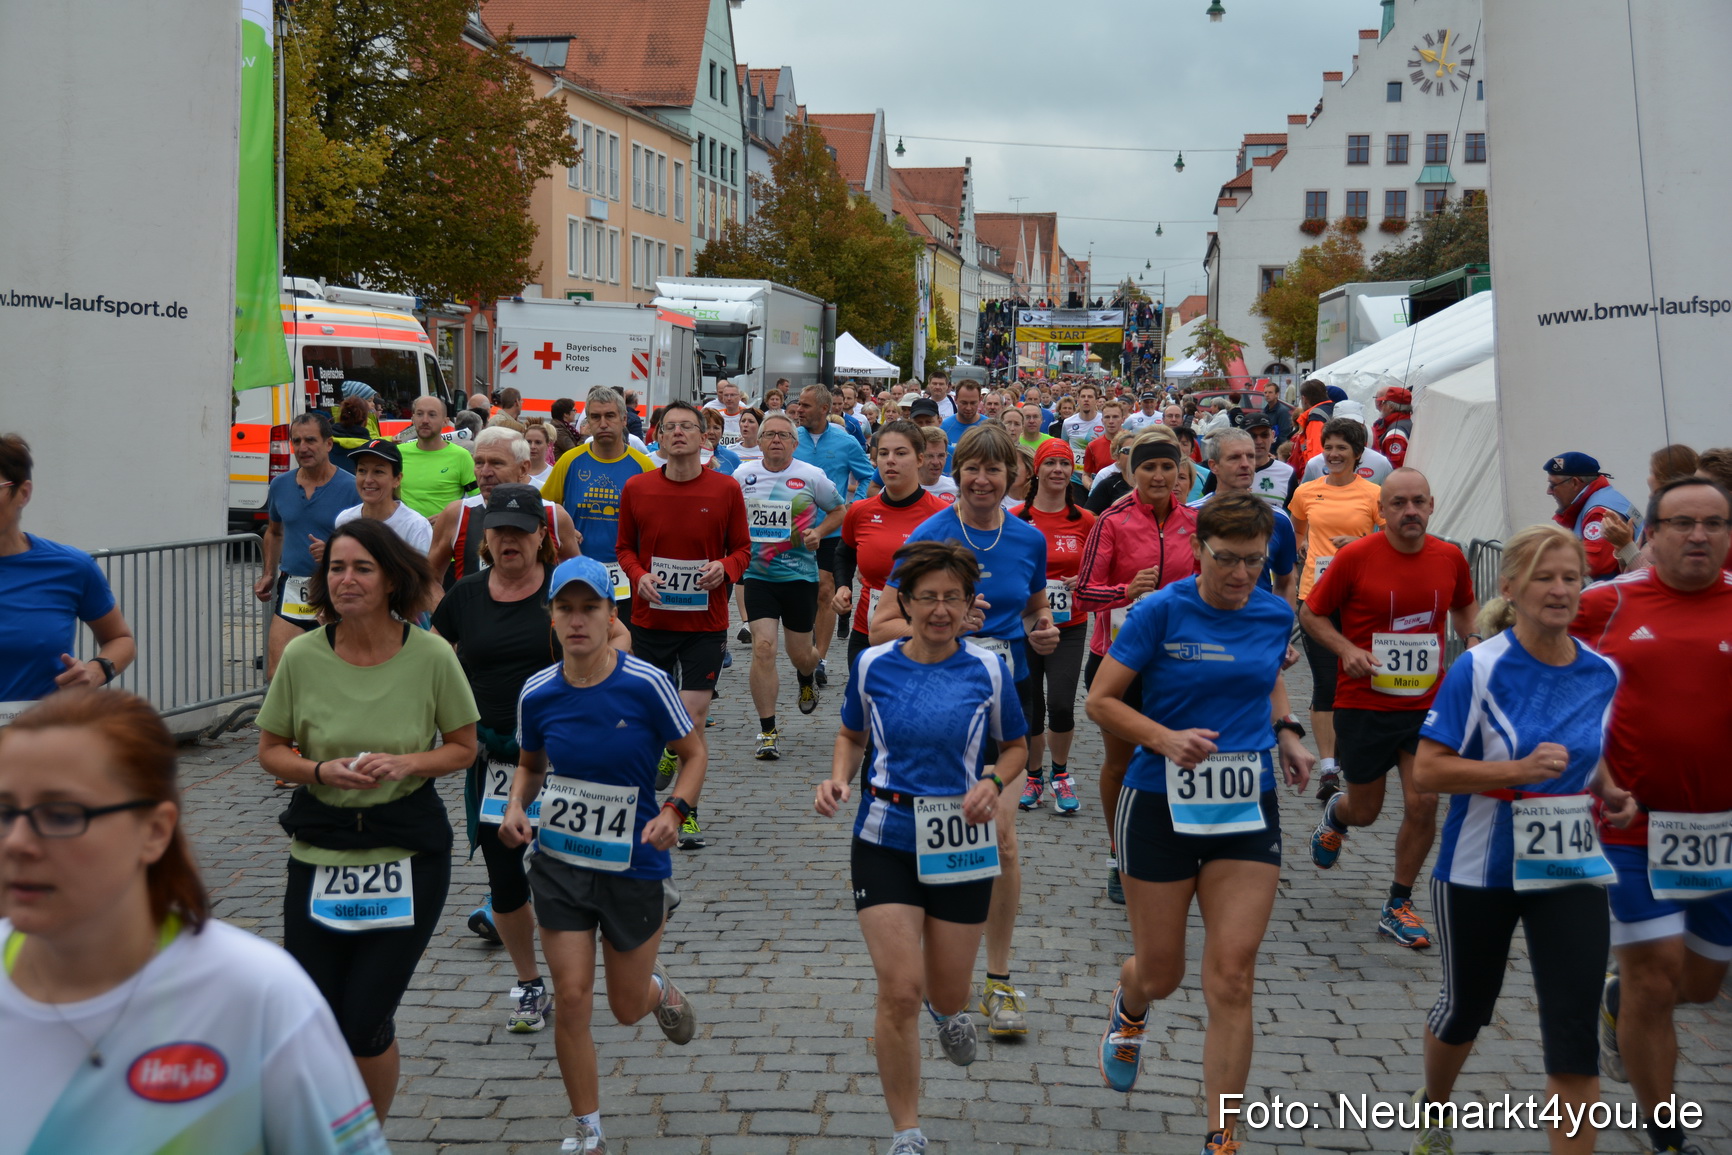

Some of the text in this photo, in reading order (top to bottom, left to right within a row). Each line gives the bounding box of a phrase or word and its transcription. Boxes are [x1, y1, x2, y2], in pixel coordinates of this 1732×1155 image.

[1050, 331, 1087, 340] START
[567, 343, 617, 353] Bayerisches
[566, 354, 590, 362] Rotes
[319, 367, 344, 382] Bayerisches
[565, 364, 590, 372] Kreuz
[838, 366, 872, 375] Laufsport
[321, 381, 334, 393] Rotes
[752, 510, 787, 527] 2544
[665, 595, 692, 604] Roland
[1387, 648, 1428, 672] 318
[1393, 677, 1419, 687] Mario
[1205, 753, 1245, 763] Neumarkt
[1177, 766, 1254, 800] 3100
[550, 783, 624, 803] PARTL Neumarkt
[917, 802, 948, 814] PARTL
[1515, 807, 1551, 816] PARTL
[549, 797, 627, 838] 2314
[1652, 820, 1728, 831] PARTL Neumarkt
[1525, 818, 1594, 855] 2148
[563, 838, 603, 857] Nicole
[1660, 832, 1732, 866] 2307
[324, 859, 403, 895] 2526
[1546, 864, 1586, 878] Conny
[1675, 873, 1723, 889] Johann
[334, 903, 388, 917] Stefanie
